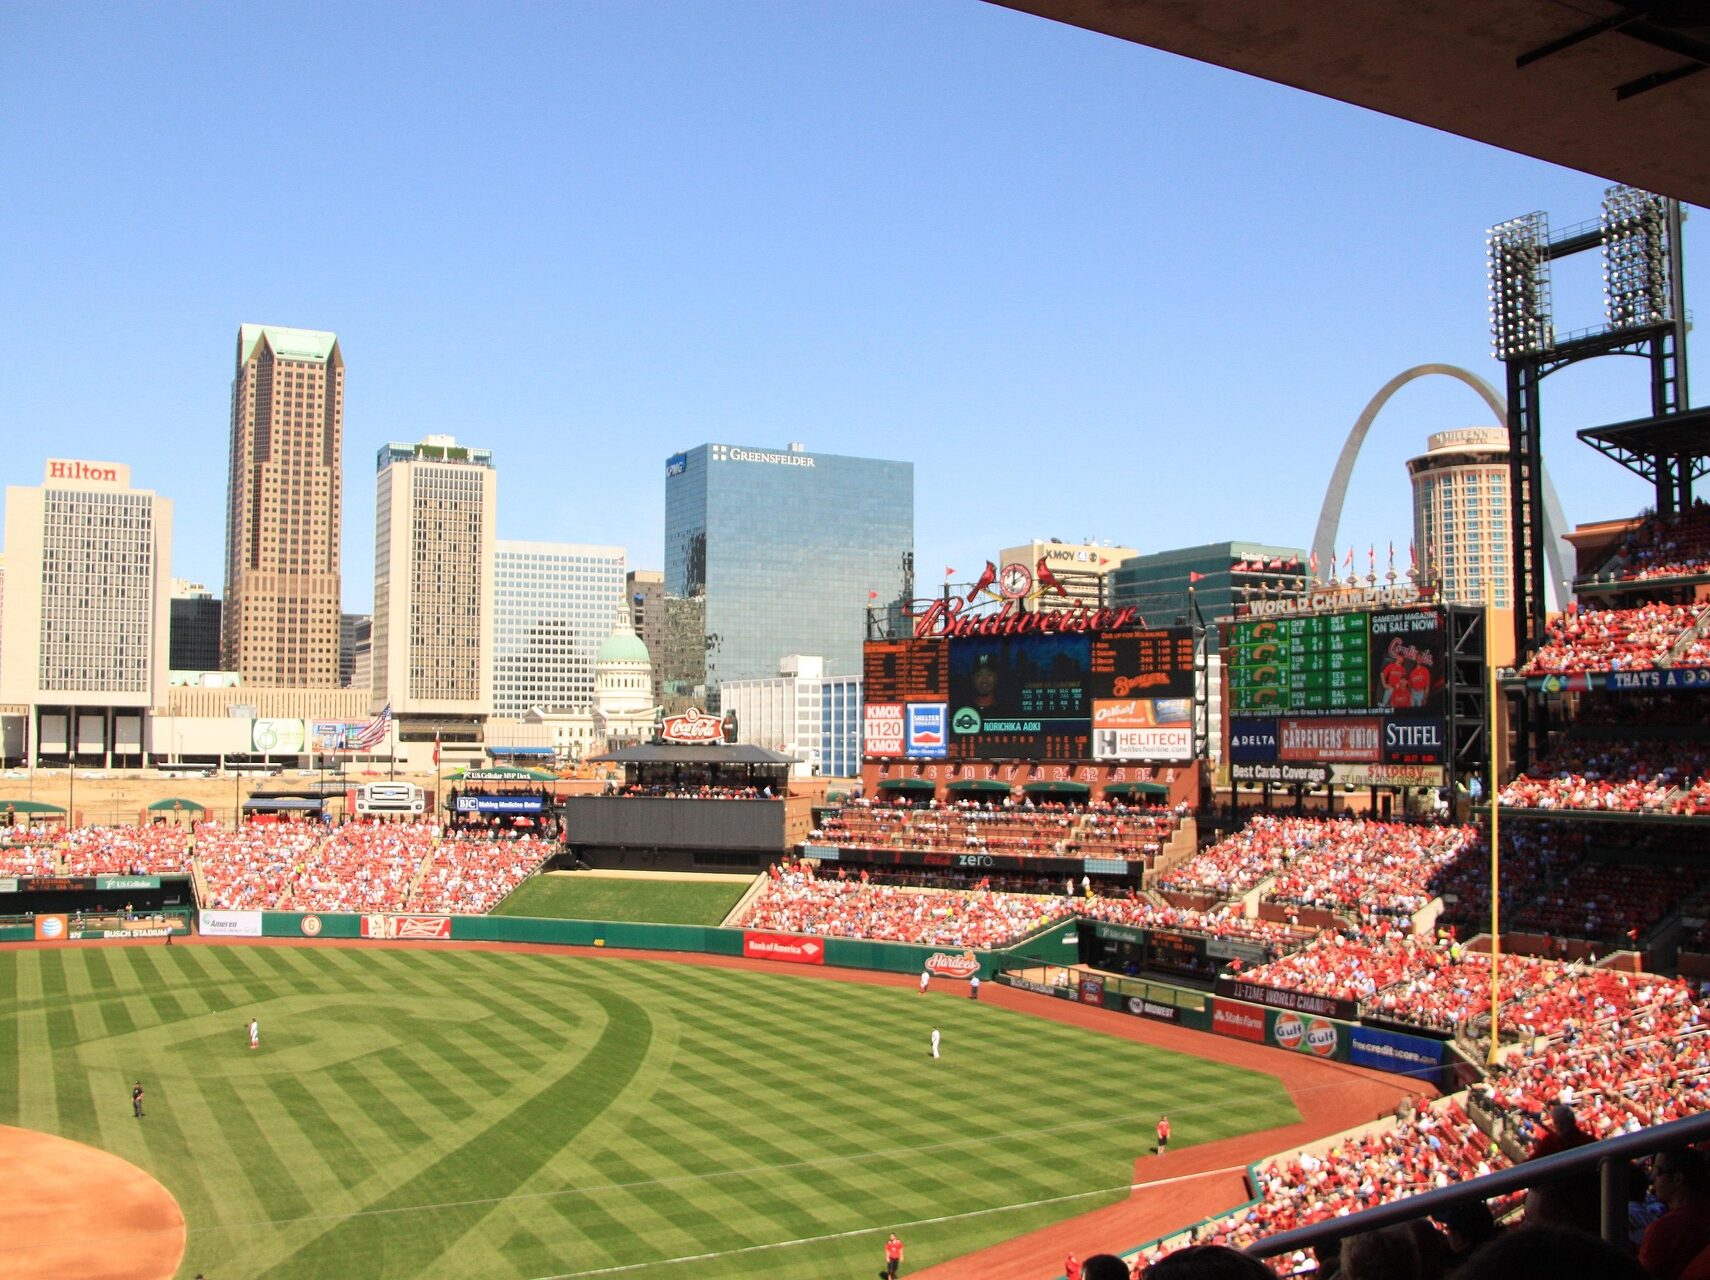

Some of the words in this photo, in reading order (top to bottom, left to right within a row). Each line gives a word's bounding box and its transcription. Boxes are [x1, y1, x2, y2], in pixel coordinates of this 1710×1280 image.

[50, 461, 117, 482] Hilton
[665, 461, 684, 477] KPMG
[1046, 549, 1076, 561] KMOV
[1250, 598, 1310, 616] WORLD
[1312, 587, 1421, 611] CHAMPIONS
[901, 596, 1139, 638] Budweiser
[1372, 614, 1403, 623] GAMEDAY
[1404, 611, 1438, 620] MAGAZINE
[1372, 623, 1388, 634] ON
[1389, 621, 1410, 632] SALE
[1411, 619, 1439, 630] NOW!
[1331, 634, 1342, 643] LA
[1614, 671, 1661, 688] THAT'S
[1666, 671, 1677, 686] A
[867, 706, 902, 718] KMOX
[868, 722, 901, 736] 1120
[983, 721, 1021, 731] NORICHIKA
[1022, 721, 1041, 731] AOKI
[1119, 733, 1187, 745] HELITECH
[1241, 735, 1275, 745] DELTA
[1349, 728, 1379, 749] UNION
[1386, 722, 1441, 746] STIFEL
[867, 739, 902, 752] KMOX
[927, 765, 937, 779] 6
[963, 765, 975, 780] 10
[1053, 767, 1072, 781] 24
[1080, 767, 1099, 782] 42
[1135, 767, 1154, 782] 85
[1232, 764, 1254, 778] Best
[1255, 764, 1281, 779] Cards
[1282, 765, 1326, 782] Coverage
[459, 799, 477, 808] BJC
[959, 855, 993, 867] zero
[210, 920, 238, 928] Ameren
[308, 919, 315, 931] 6
[103, 930, 132, 938] BUSCH
[132, 929, 168, 937] STADIUM
[749, 940, 766, 950] Bank
[774, 943, 802, 955] America
[1233, 983, 1265, 1001] 11-TIME
[1265, 989, 1296, 1007] WORLD
[1296, 995, 1337, 1015] CHAMPS
[1144, 1002, 1175, 1019] MIDWEST
[1276, 1023, 1302, 1037] Gulf
[1307, 1030, 1335, 1044] Gulf
